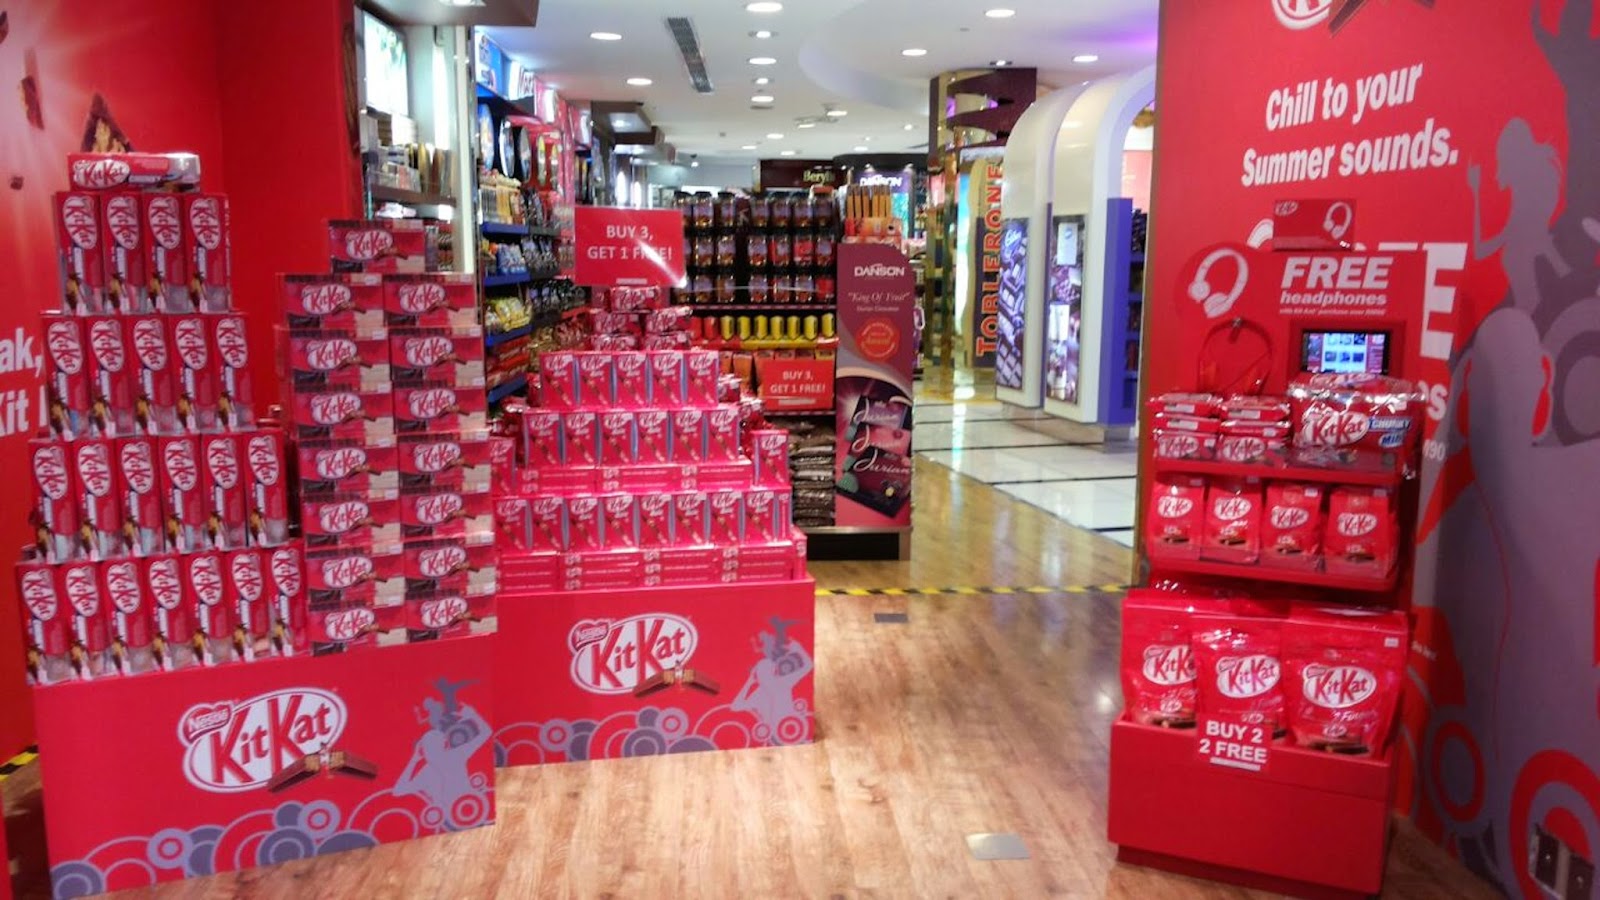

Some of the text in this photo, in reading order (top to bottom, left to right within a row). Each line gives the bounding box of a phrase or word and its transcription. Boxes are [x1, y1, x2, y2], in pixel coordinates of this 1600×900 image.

[1266, 63, 1423, 131] Chill to your
[1241, 118, 1459, 188] Summer sounds.
[606, 224, 654, 241] BUY 3,
[587, 245, 617, 259] GET
[620, 246, 628, 259] 1
[975, 164, 1003, 357] TOBLERONE
[854, 264, 905, 277] DANSON
[1281, 256, 1394, 290] FREE
[1280, 291, 1387, 306] headphones
[770, 383, 789, 394] GET
[792, 384, 797, 393] 1
[783, 370, 803, 380] BUY
[1312, 412, 1365, 446] KitKat
[592, 618, 686, 688] KitKat
[1228, 657, 1276, 694] KitKat
[1313, 667, 1368, 704] KitKat
[210, 694, 332, 784] KitKat
[1206, 720, 1263, 743] BUY 2
[1199, 738, 1268, 764] 2 FREE
